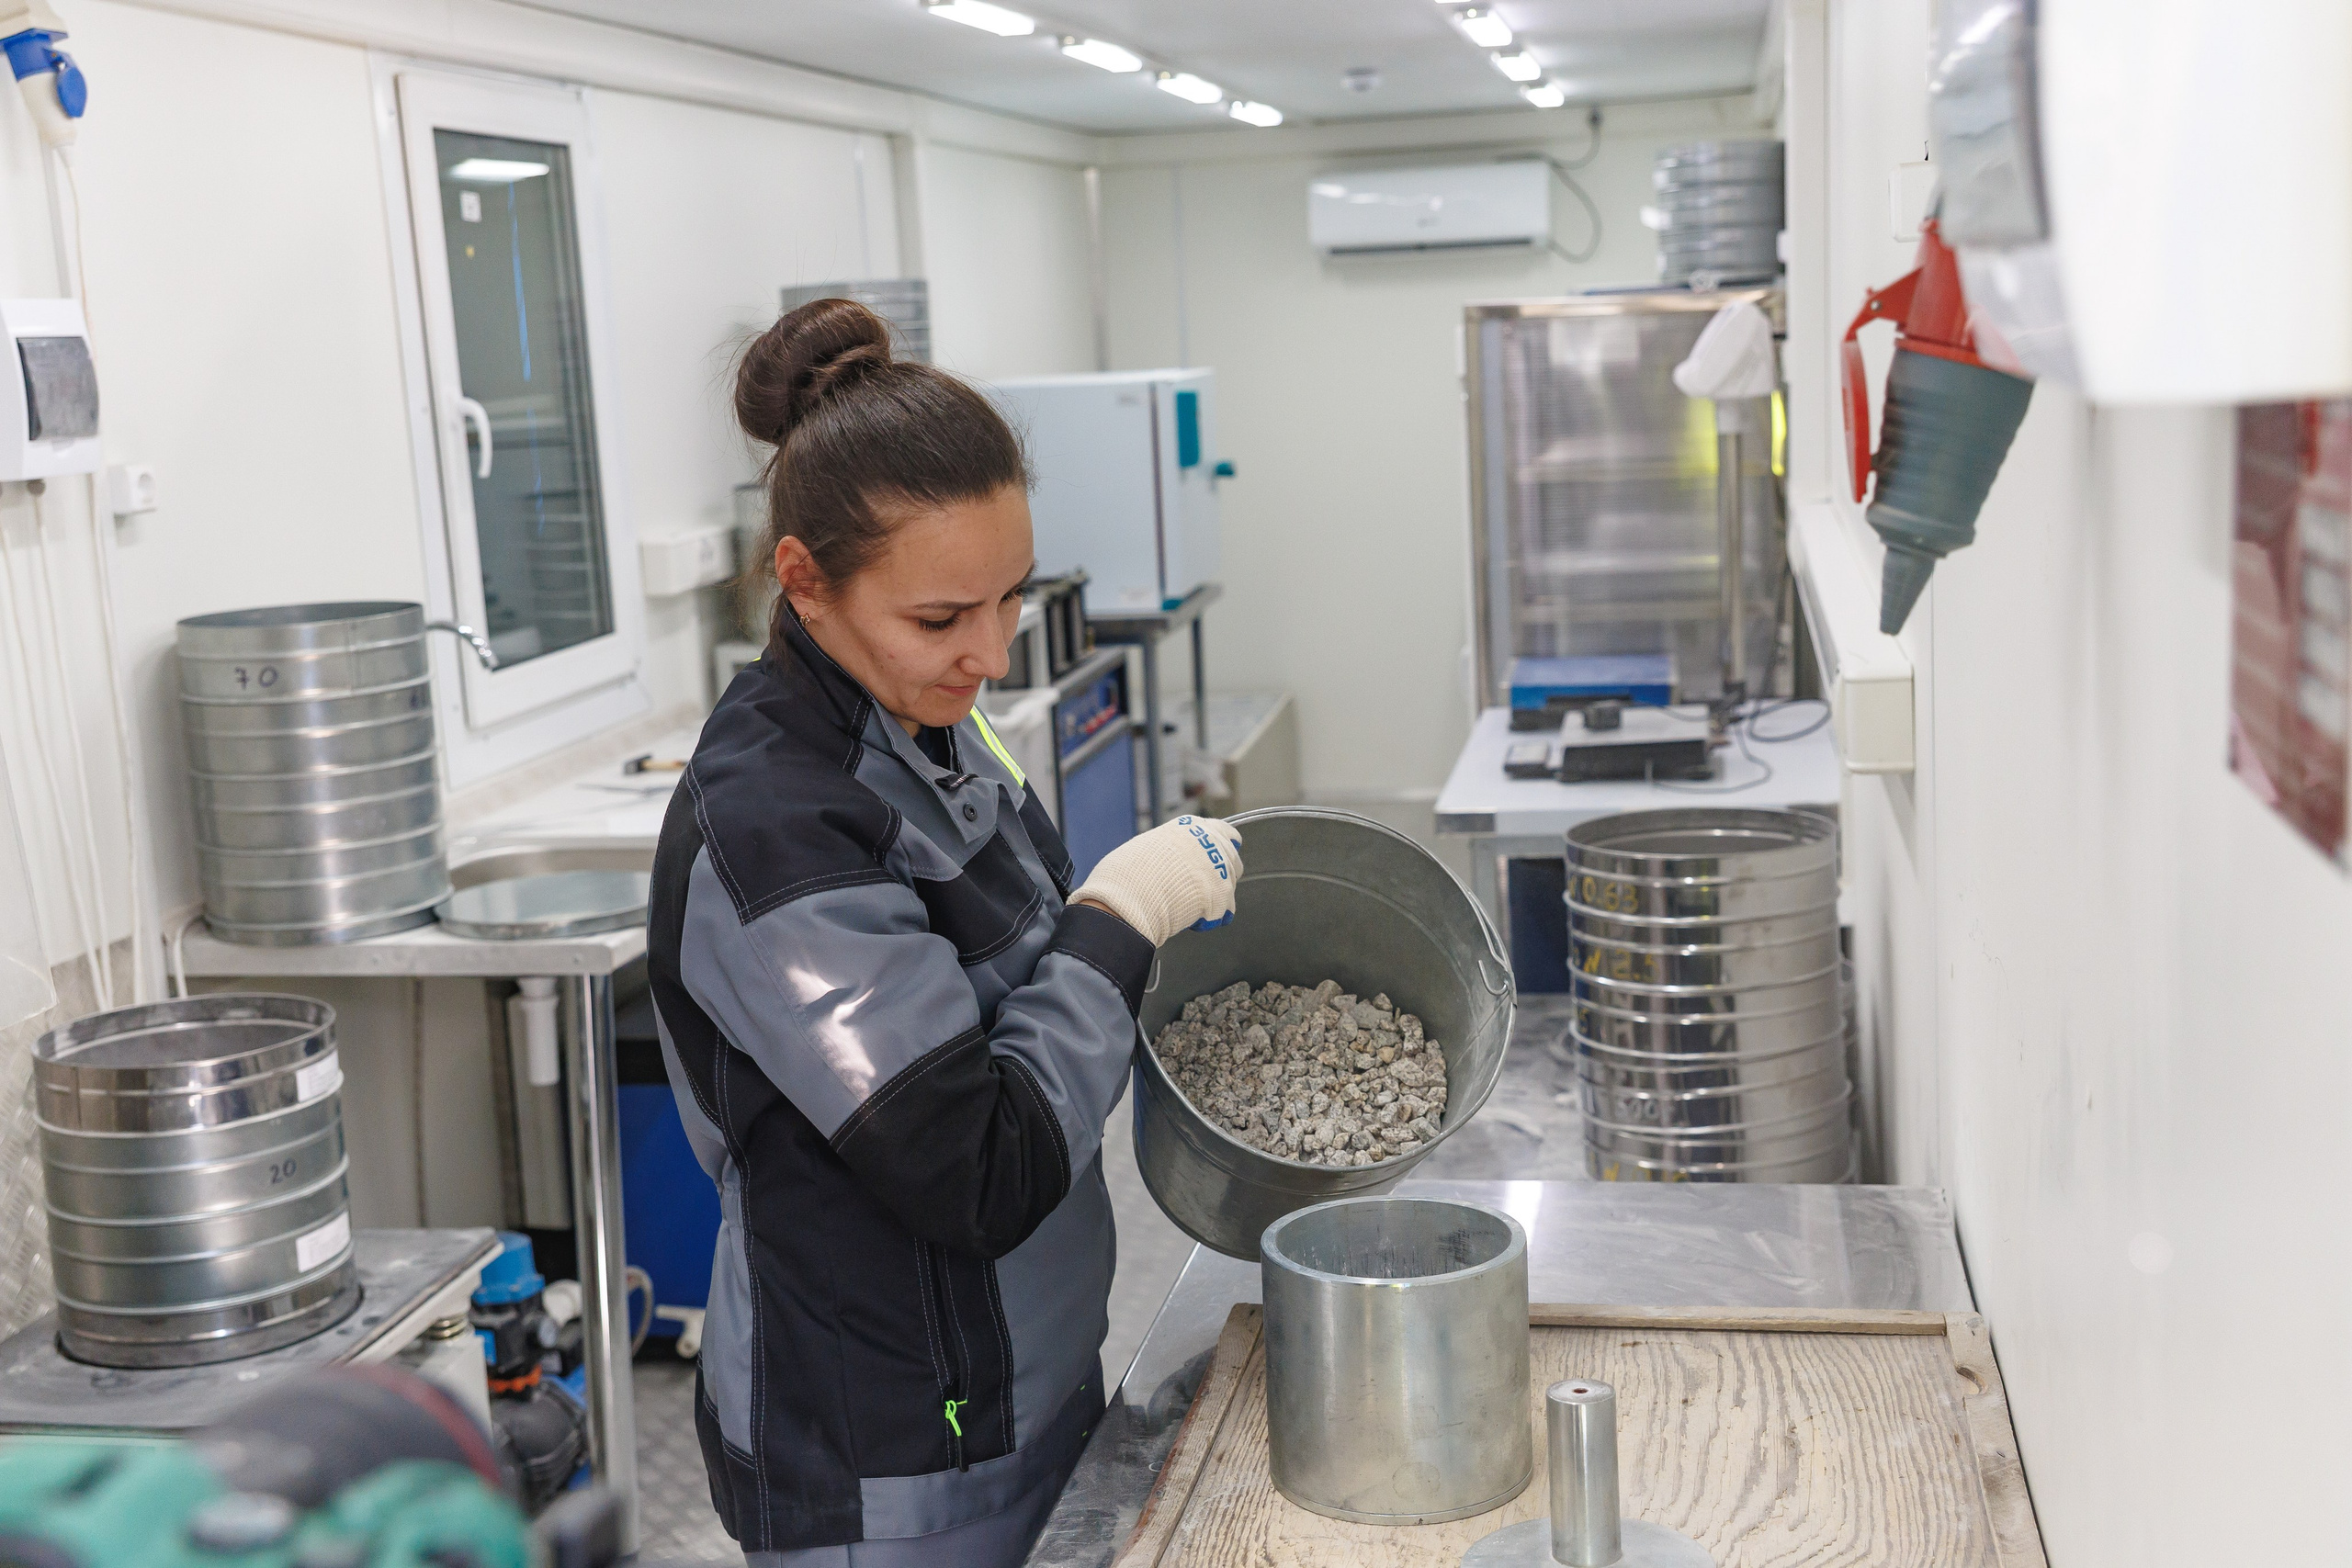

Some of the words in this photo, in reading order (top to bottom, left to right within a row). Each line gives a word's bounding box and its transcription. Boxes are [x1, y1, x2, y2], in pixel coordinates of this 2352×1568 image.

[234, 666, 279, 690] 70
[1189, 825, 1228, 880] ЗУБР
[269, 1157, 298, 1184] 20
